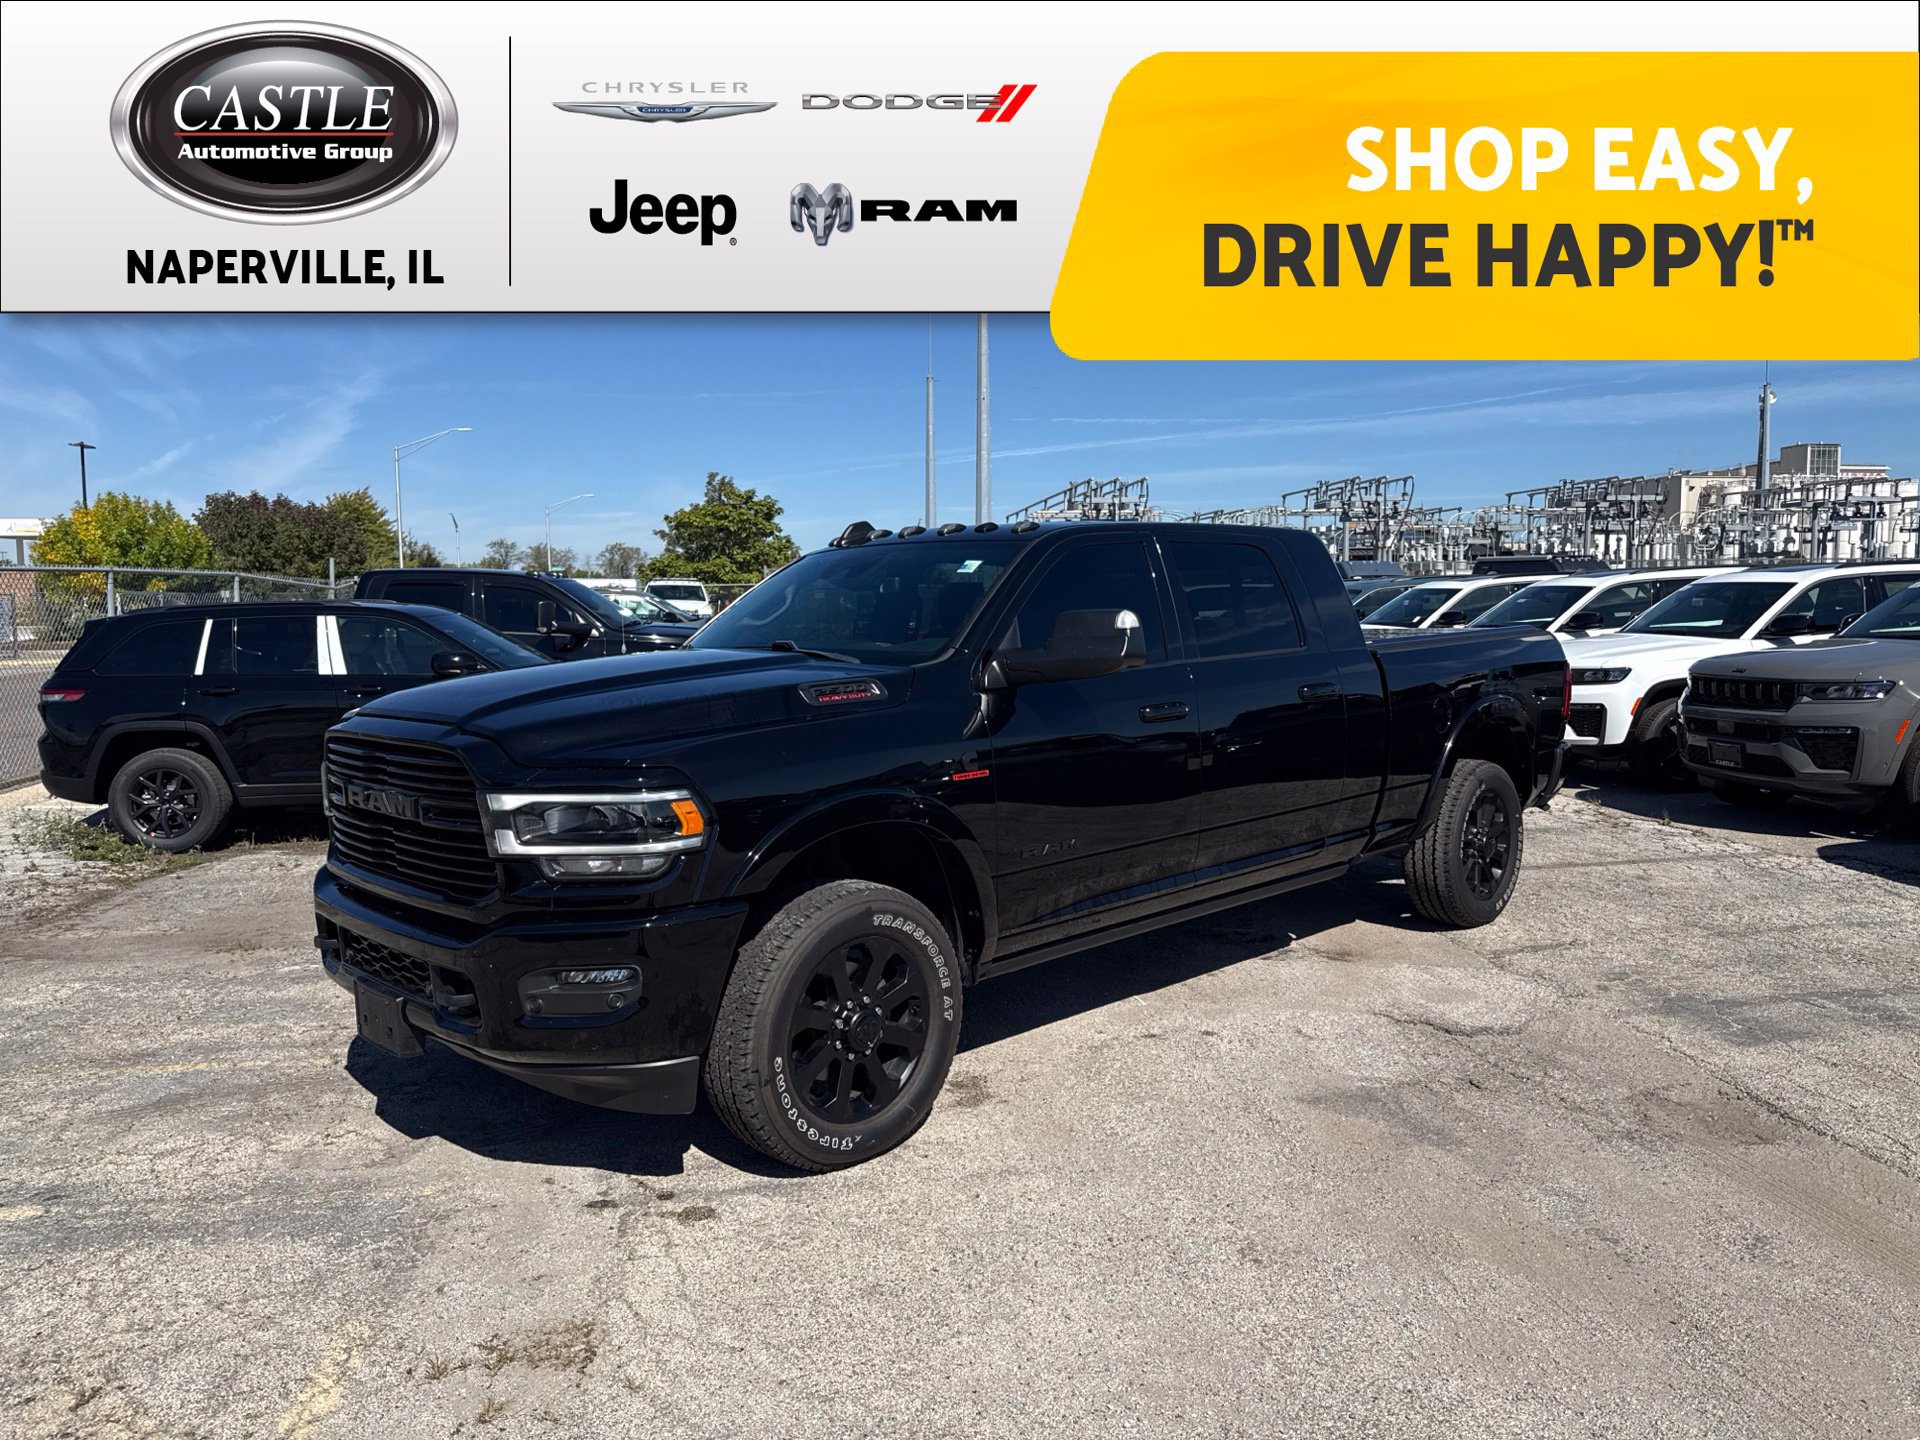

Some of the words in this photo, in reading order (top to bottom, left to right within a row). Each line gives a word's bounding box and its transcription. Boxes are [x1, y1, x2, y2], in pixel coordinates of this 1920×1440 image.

[347, 784, 417, 819] RAM
[873, 914, 951, 989] TRANSFORCE
[943, 995, 954, 1022] AT
[774, 1056, 854, 1150] Firestone
